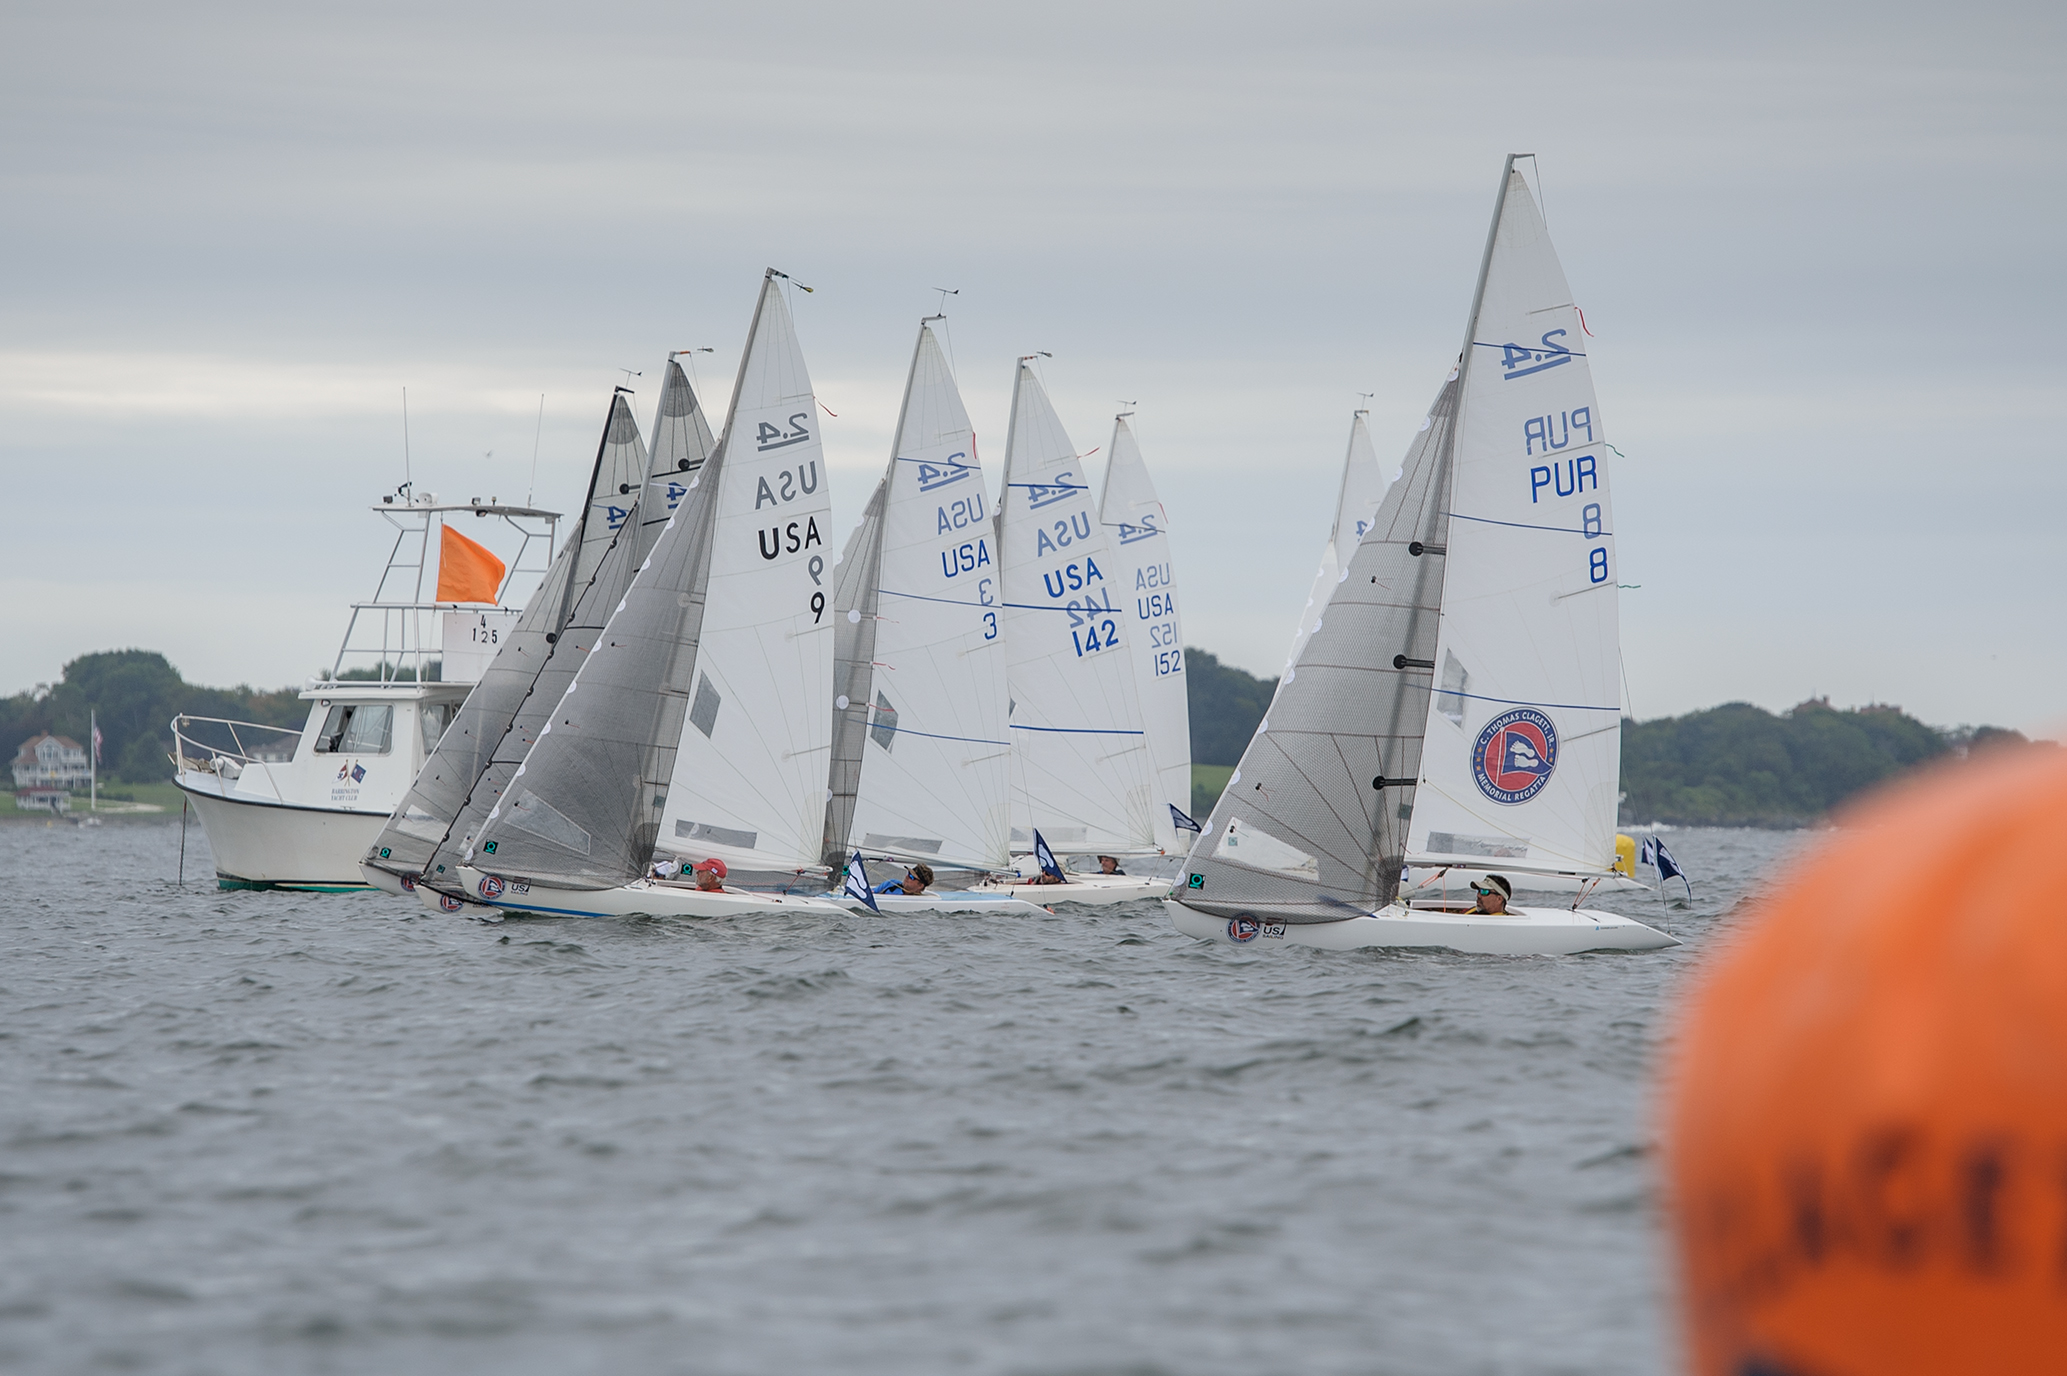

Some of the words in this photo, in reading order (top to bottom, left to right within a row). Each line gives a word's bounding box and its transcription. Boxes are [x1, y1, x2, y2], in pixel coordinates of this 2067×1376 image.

[1530, 455, 1598, 504] PUR
[758, 516, 822, 560] USA
[941, 539, 991, 578] USA
[1589, 547, 1608, 584] 8
[1043, 557, 1104, 598] USA
[810, 592, 825, 624] 9
[1137, 592, 1174, 620] USA
[481, 614, 486, 628] 4
[983, 612, 997, 640] 3
[1072, 619, 1119, 657] 142
[1154, 650, 1181, 676] 152
[1487, 712, 1520, 735] THOMAS
[1478, 773, 1512, 801] MEMORIAL
[1514, 776, 1546, 801] REGATTA
[511, 883, 526, 892] US
[1263, 926, 1280, 935] US
